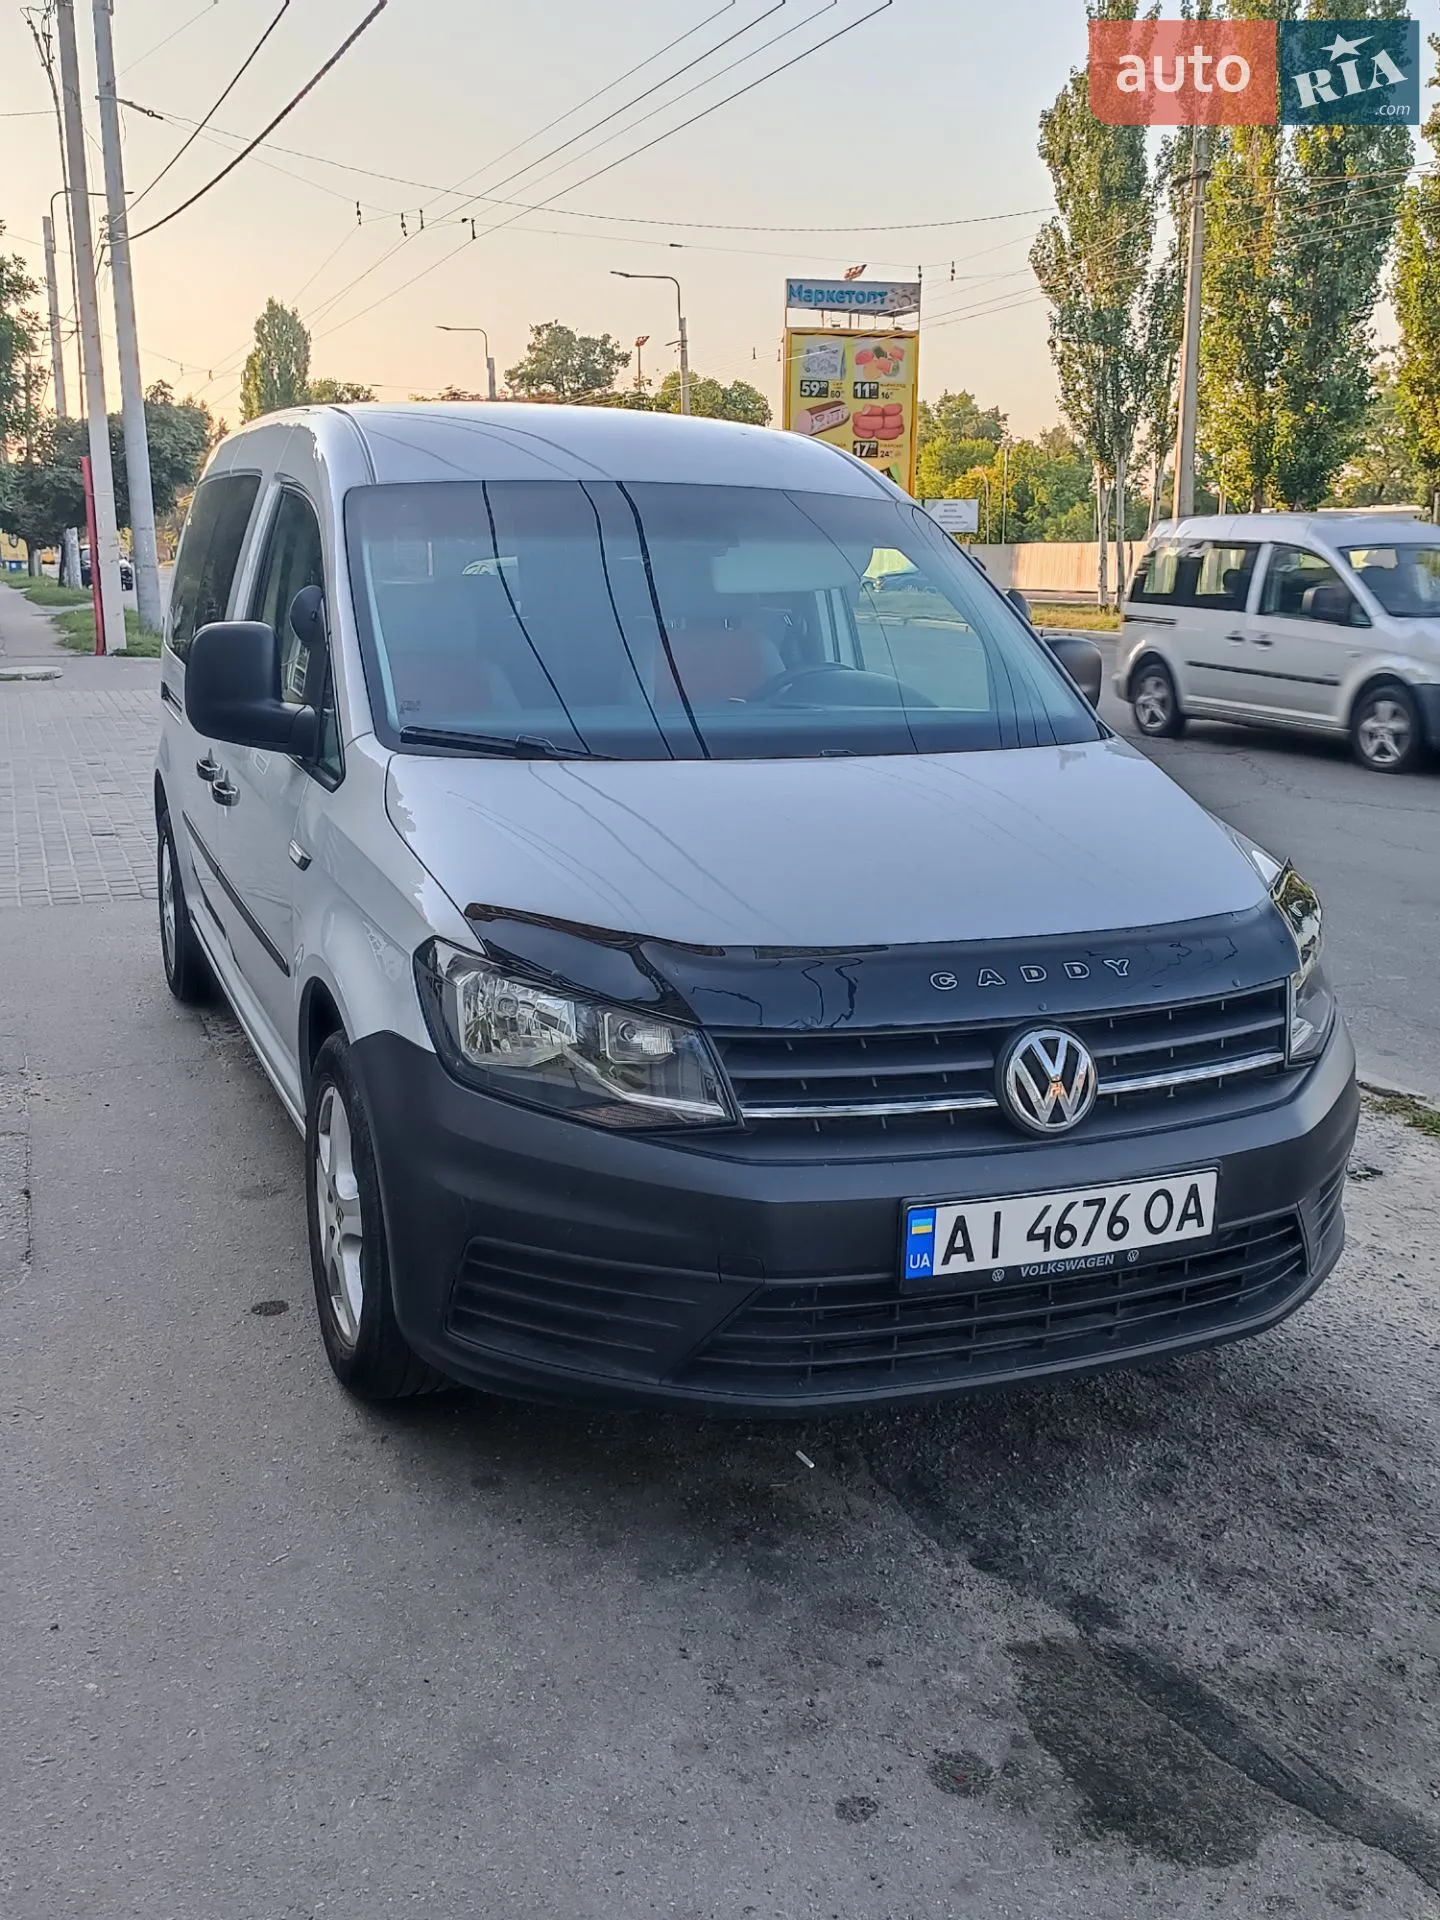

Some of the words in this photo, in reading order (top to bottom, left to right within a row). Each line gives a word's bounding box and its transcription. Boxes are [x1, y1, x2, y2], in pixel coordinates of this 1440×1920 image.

[788, 283, 888, 306] Маркетопт
[929, 958, 1130, 990] CADDY
[941, 1210, 1002, 1266] AI
[1026, 1192, 1132, 1253] 4676
[1143, 1183, 1205, 1236] OA
[909, 1252, 931, 1270] UA
[1020, 1254, 1115, 1278] VOLKSWAGEN
